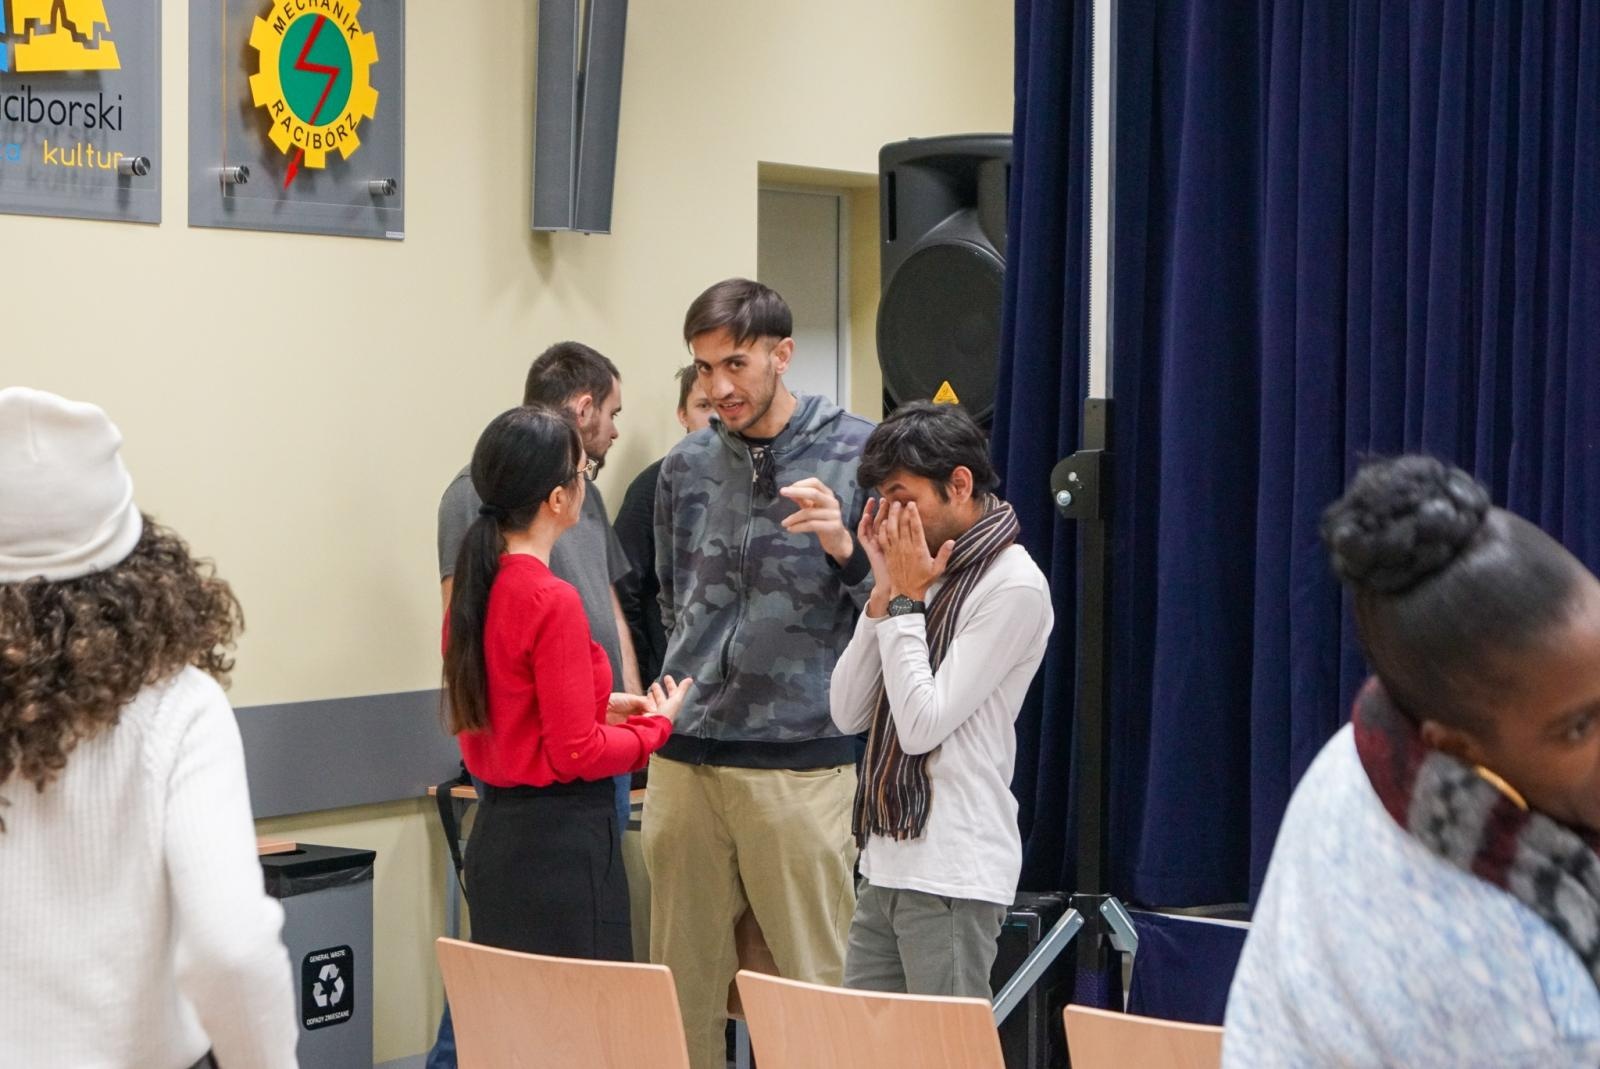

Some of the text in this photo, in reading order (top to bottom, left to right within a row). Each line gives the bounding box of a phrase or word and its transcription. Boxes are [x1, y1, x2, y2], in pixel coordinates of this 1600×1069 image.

[273, 0, 359, 39] MECHANIK
[0, 84, 122, 131] ciborski
[272, 99, 357, 149] RACIBÓRZ
[309, 950, 346, 963] GENERAL WASTE
